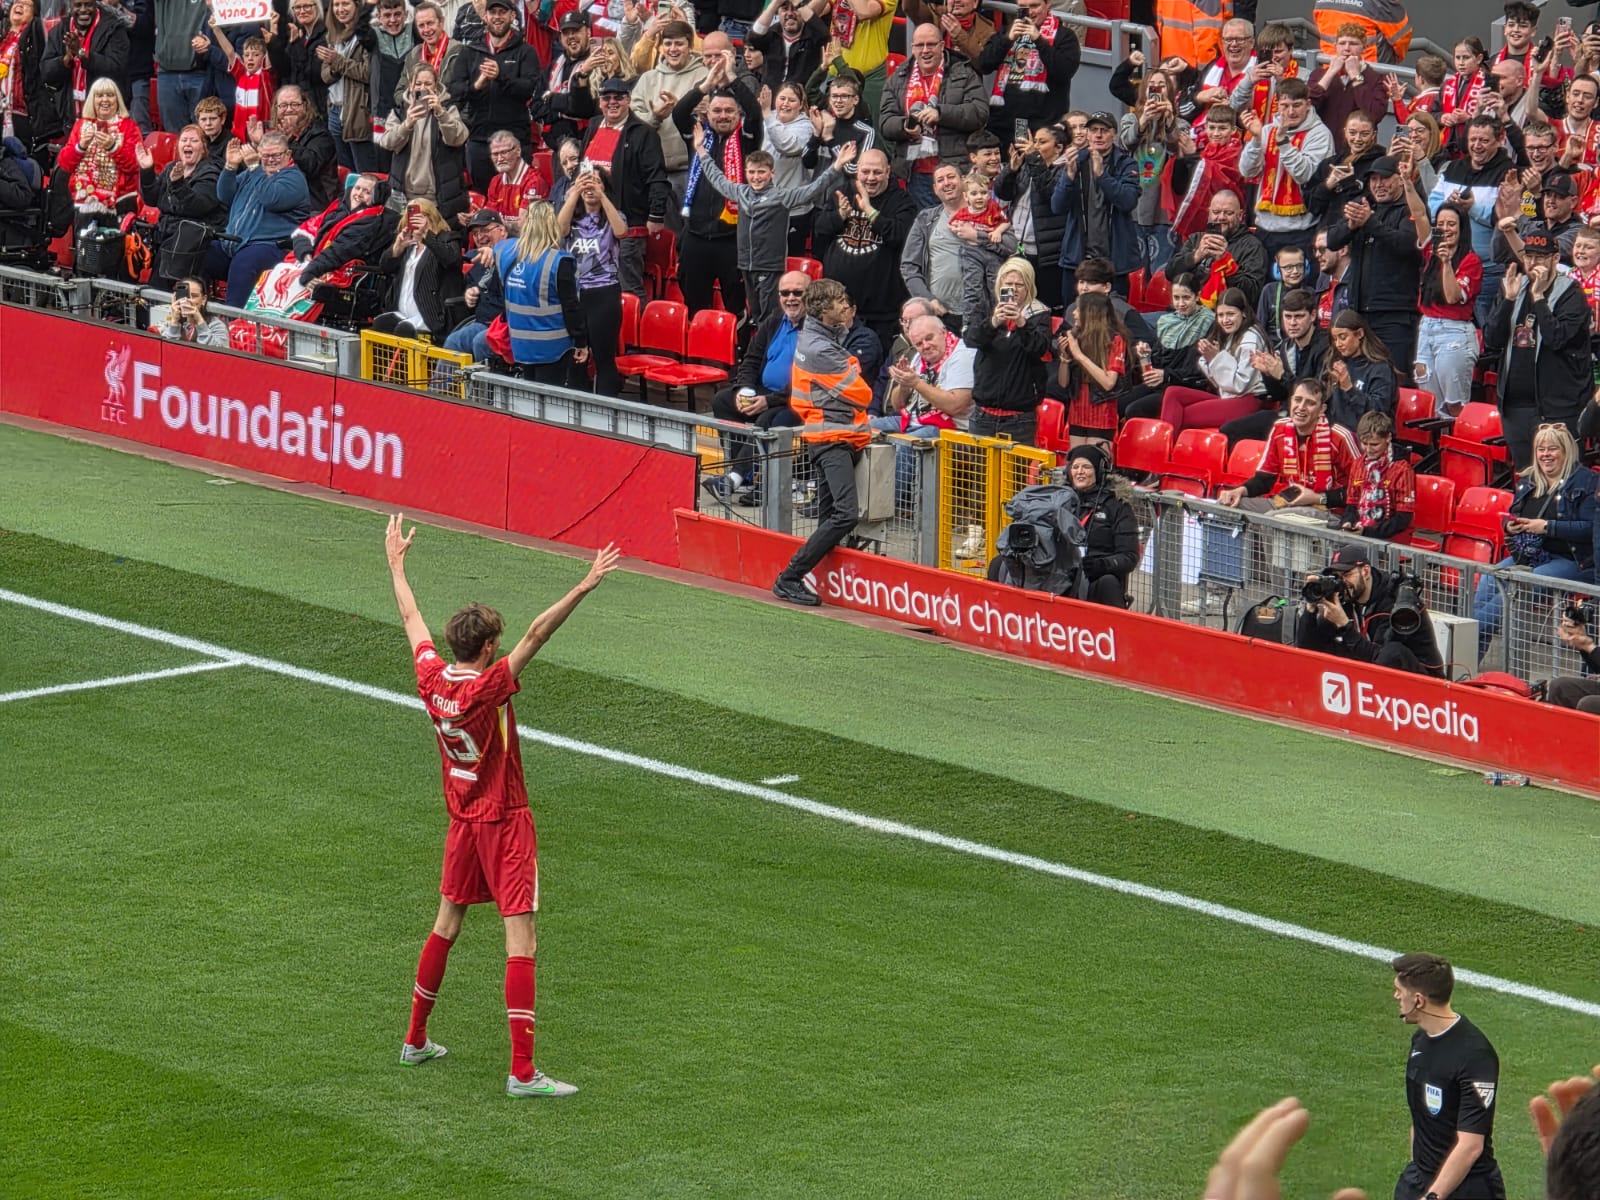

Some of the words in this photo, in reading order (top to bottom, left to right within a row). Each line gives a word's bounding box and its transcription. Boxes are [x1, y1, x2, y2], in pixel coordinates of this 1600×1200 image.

[219, 2, 267, 19] Crouch
[570, 238, 600, 254] AXA
[101, 404, 128, 425] LFC
[132, 360, 404, 479] Foundation
[828, 567, 961, 626] standard
[969, 601, 1116, 662] chartered
[1358, 683, 1479, 742] Expedia
